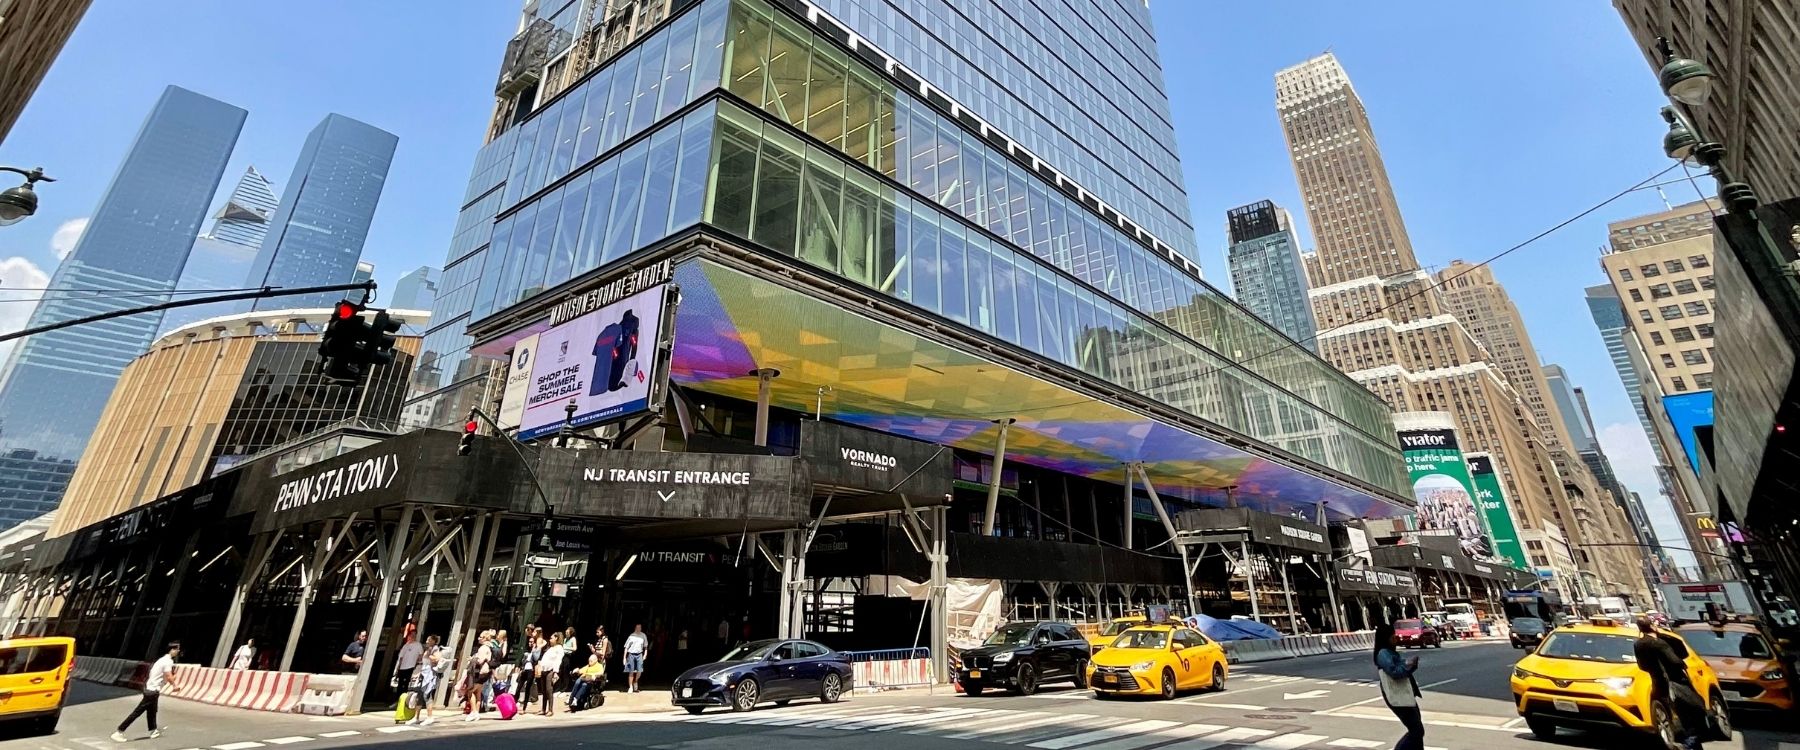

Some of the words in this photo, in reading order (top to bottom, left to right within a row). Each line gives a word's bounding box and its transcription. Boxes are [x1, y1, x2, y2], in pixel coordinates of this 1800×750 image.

[550, 296, 588, 326] MADISON
[590, 278, 626, 309] SQUARE
[631, 258, 672, 293] GARDEN
[509, 371, 529, 385] CHASE
[537, 370, 561, 385] SHOP
[563, 364, 580, 377] THE
[538, 375, 576, 393] SUMMER
[529, 389, 559, 405] MERCH
[560, 381, 583, 397] SALE
[1402, 433, 1445, 447] viator
[841, 447, 896, 467] VORNADO
[1413, 454, 1440, 463] traffic
[1440, 454, 1459, 463] jams
[274, 475, 315, 513] PENN
[311, 454, 388, 504] STATION
[583, 468, 603, 481] NJ
[609, 468, 671, 483] TRANSIT
[674, 470, 750, 484] ENTRANCE
[1476, 489, 1493, 498] ork
[557, 522, 581, 532] Seventh
[582, 524, 594, 533] Ave
[555, 539, 565, 547] Joe
[640, 551, 655, 562] NJ
[657, 551, 706, 563] TRANSIT
